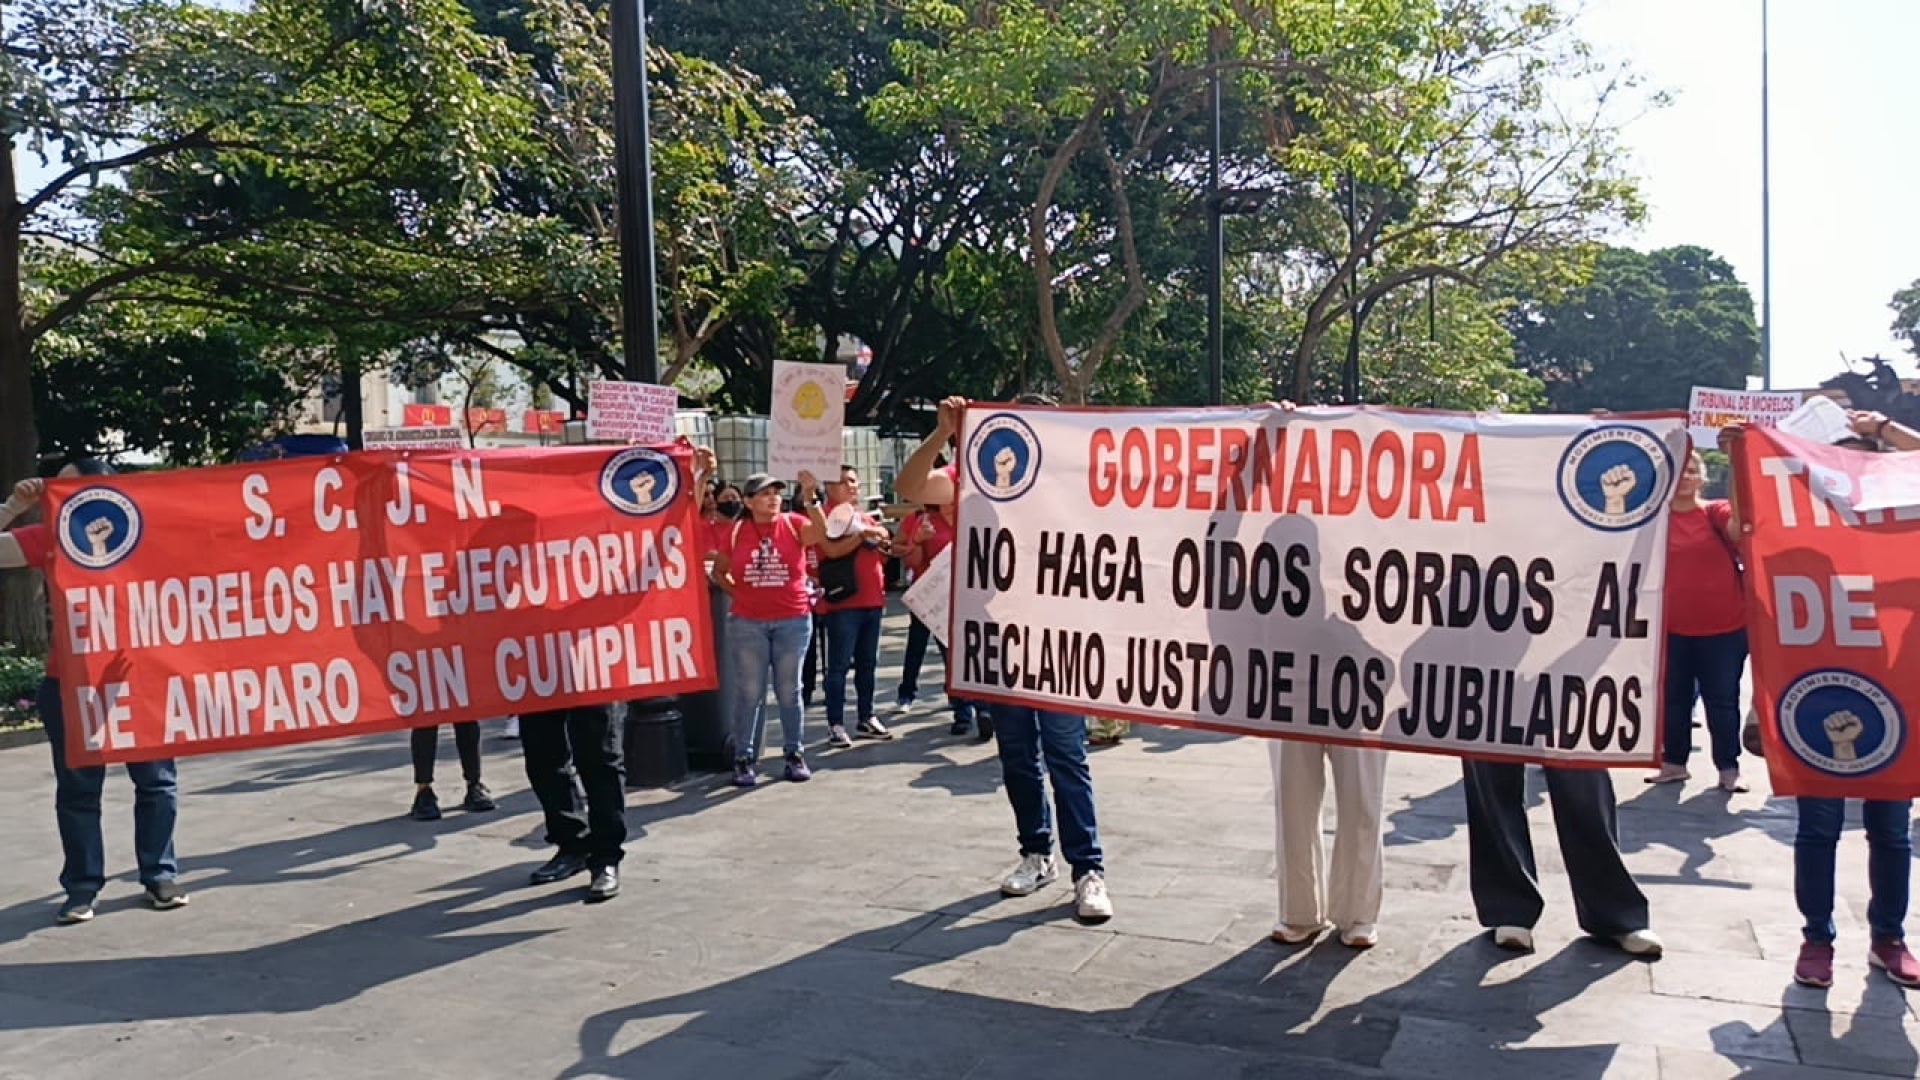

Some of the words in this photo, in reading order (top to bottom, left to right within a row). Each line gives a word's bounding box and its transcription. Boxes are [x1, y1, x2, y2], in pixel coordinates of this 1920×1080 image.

[1697, 391, 1736, 410] TRIBUNAL
[1739, 395, 1751, 410] DE
[1752, 395, 1795, 412] MORELOS
[1089, 429, 1486, 522] GOBERNADORA
[1569, 430, 1642, 465] MOVIMIENTO
[244, 475, 285, 539] S.
[315, 468, 357, 532] C.
[386, 462, 426, 525] J.
[452, 459, 501, 518] N.
[66, 587, 116, 654] EN
[129, 566, 318, 647] MORELOS
[330, 558, 407, 626] HAY
[422, 528, 685, 616] EJECUTORIAS
[967, 527, 1015, 591] NO
[1038, 531, 1143, 603] HAGA
[1173, 522, 1310, 616] OÍDOS
[1343, 548, 1554, 634] SORDOS
[1587, 563, 1648, 638] AL
[1773, 576, 1882, 647] DE
[77, 683, 135, 750] DE
[165, 658, 360, 744] AMPARO
[387, 646, 468, 716] SIN
[496, 619, 696, 701] CUMPLIR
[963, 620, 1104, 689] RECLAMO
[1116, 638, 1233, 717] JUSTO
[1247, 648, 1294, 723] DE
[1308, 654, 1385, 730] LOS
[1397, 663, 1641, 752] JUBILADOS
[1785, 674, 1861, 711] MOVIMIENTO
